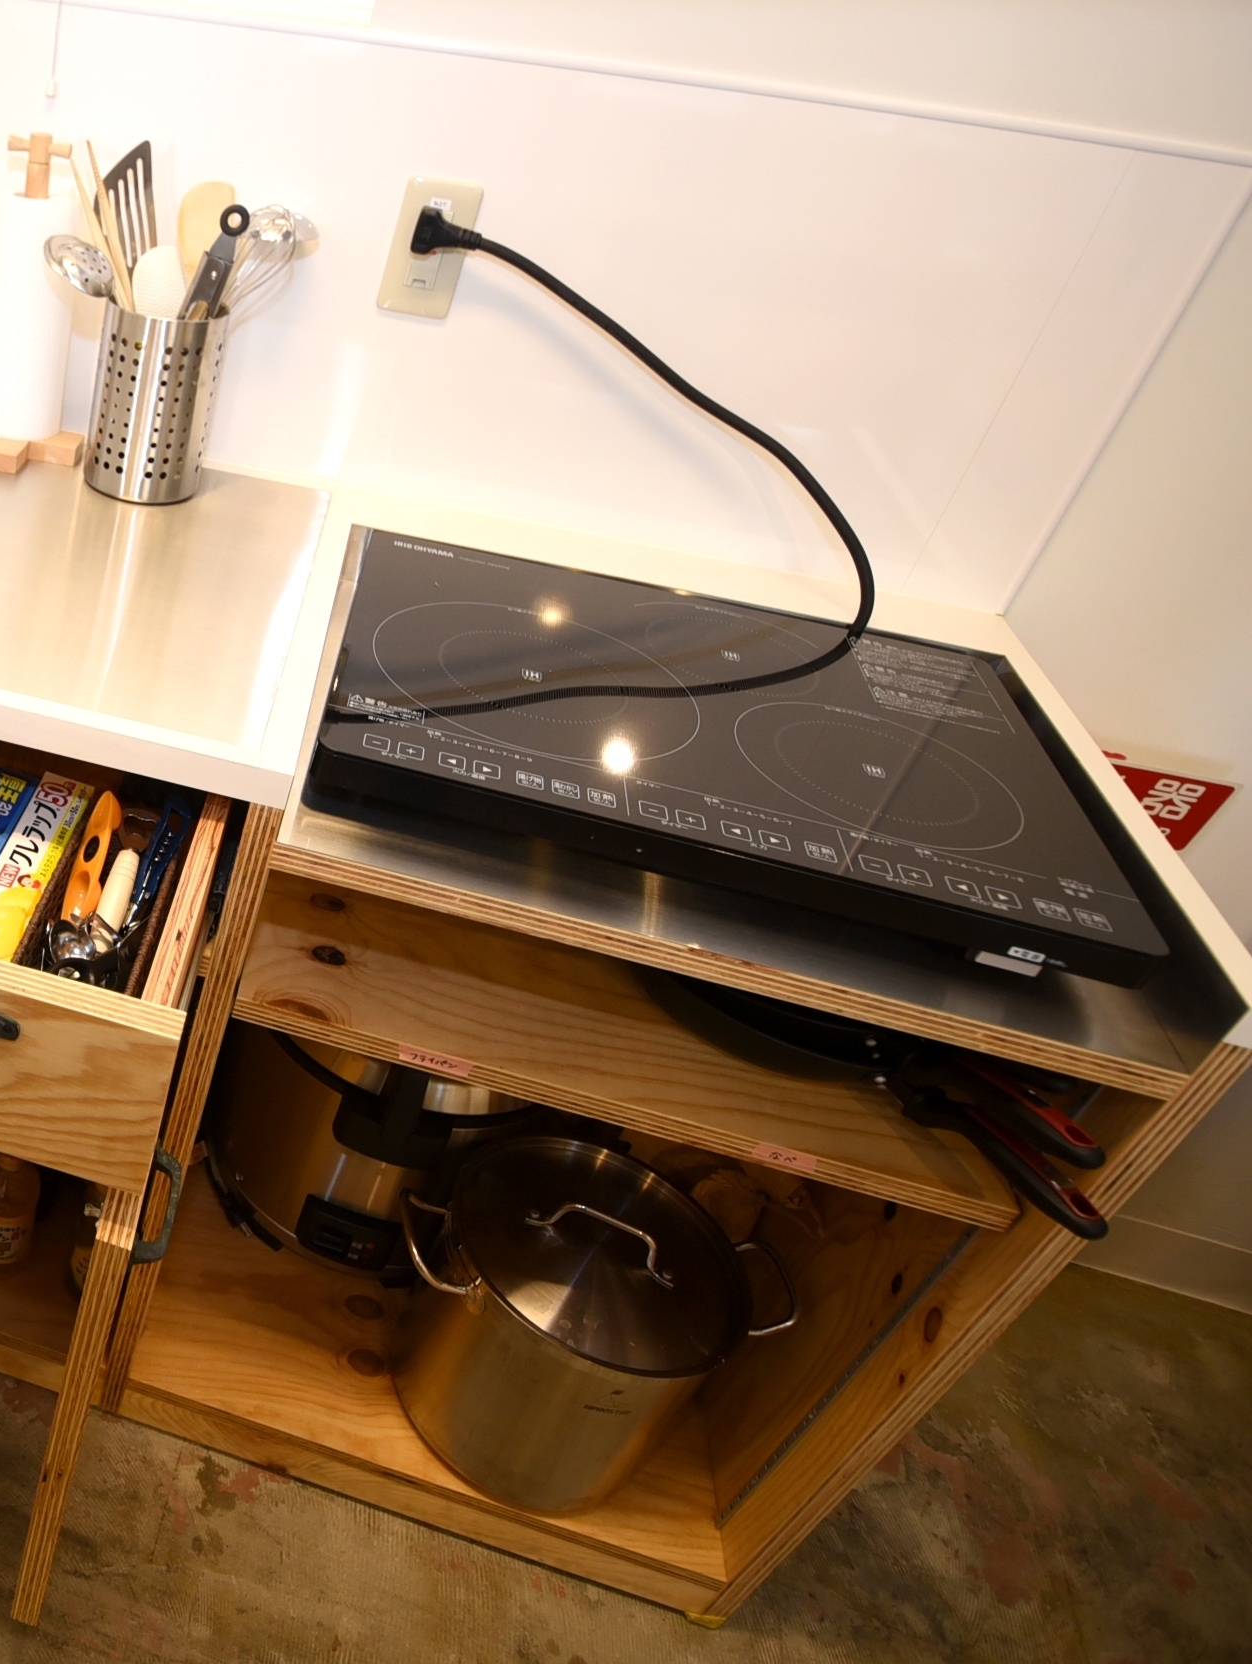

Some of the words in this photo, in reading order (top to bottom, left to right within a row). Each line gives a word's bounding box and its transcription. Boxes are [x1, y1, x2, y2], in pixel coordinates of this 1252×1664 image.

[394, 540, 412, 549] IRIS
[414, 544, 454, 558] OHYAMA
[518, 773, 541, 784] 揚げ物
[590, 790, 613, 802] 加熱
[9, 801, 57, 867] クレラップ
[410, 1053, 458, 1068] フライパン
[769, 1151, 797, 1164] なべ
